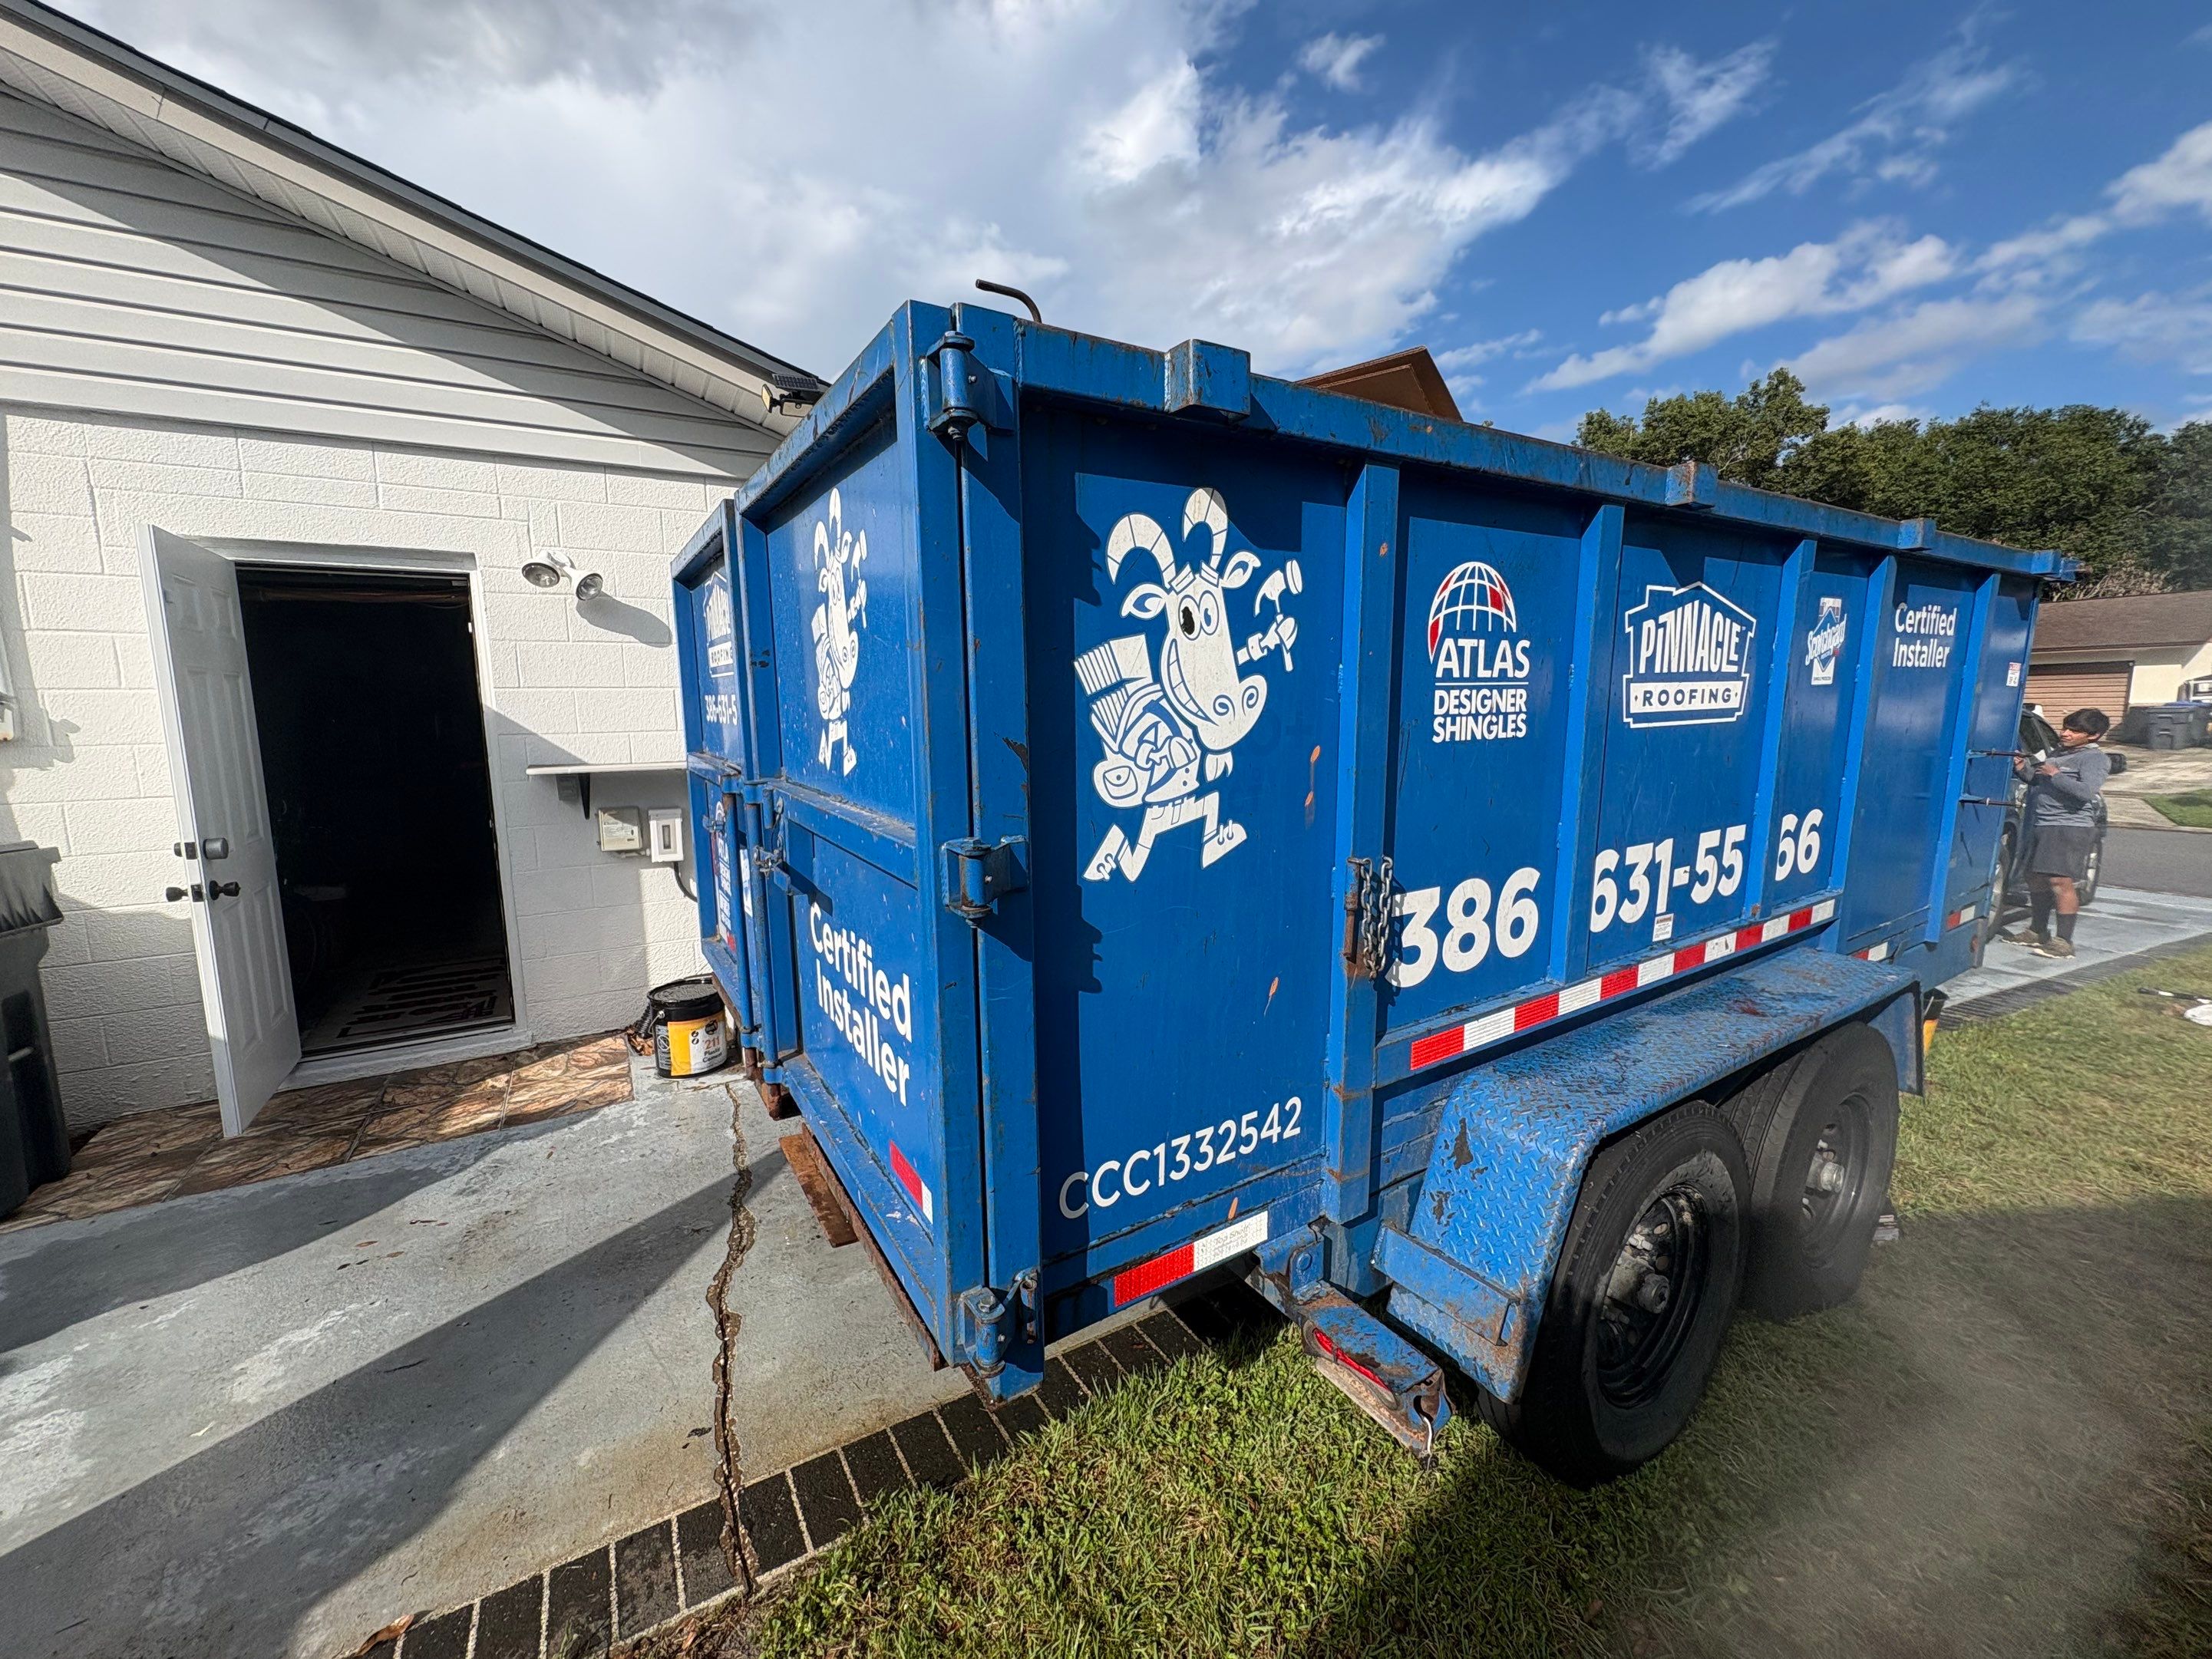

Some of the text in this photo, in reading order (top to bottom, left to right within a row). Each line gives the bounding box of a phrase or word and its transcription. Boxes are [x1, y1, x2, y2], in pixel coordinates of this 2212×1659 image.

[1639, 600, 1741, 674] PINNACLE
[1894, 602, 1957, 636] Certified
[1435, 638, 1530, 678] ATLAS
[1893, 638, 1950, 669] Installer
[1434, 688, 1527, 715] DESIGNER
[1642, 688, 1732, 707] ROOFING
[1432, 714, 1527, 743] SHINGLES
[1385, 808, 1821, 988] 386 631-55 66
[809, 902, 913, 1043] Certified
[705, 1036, 721, 1050] 211
[816, 958, 910, 1107] Installer
[1059, 1097, 1302, 1219] CCC1332542
